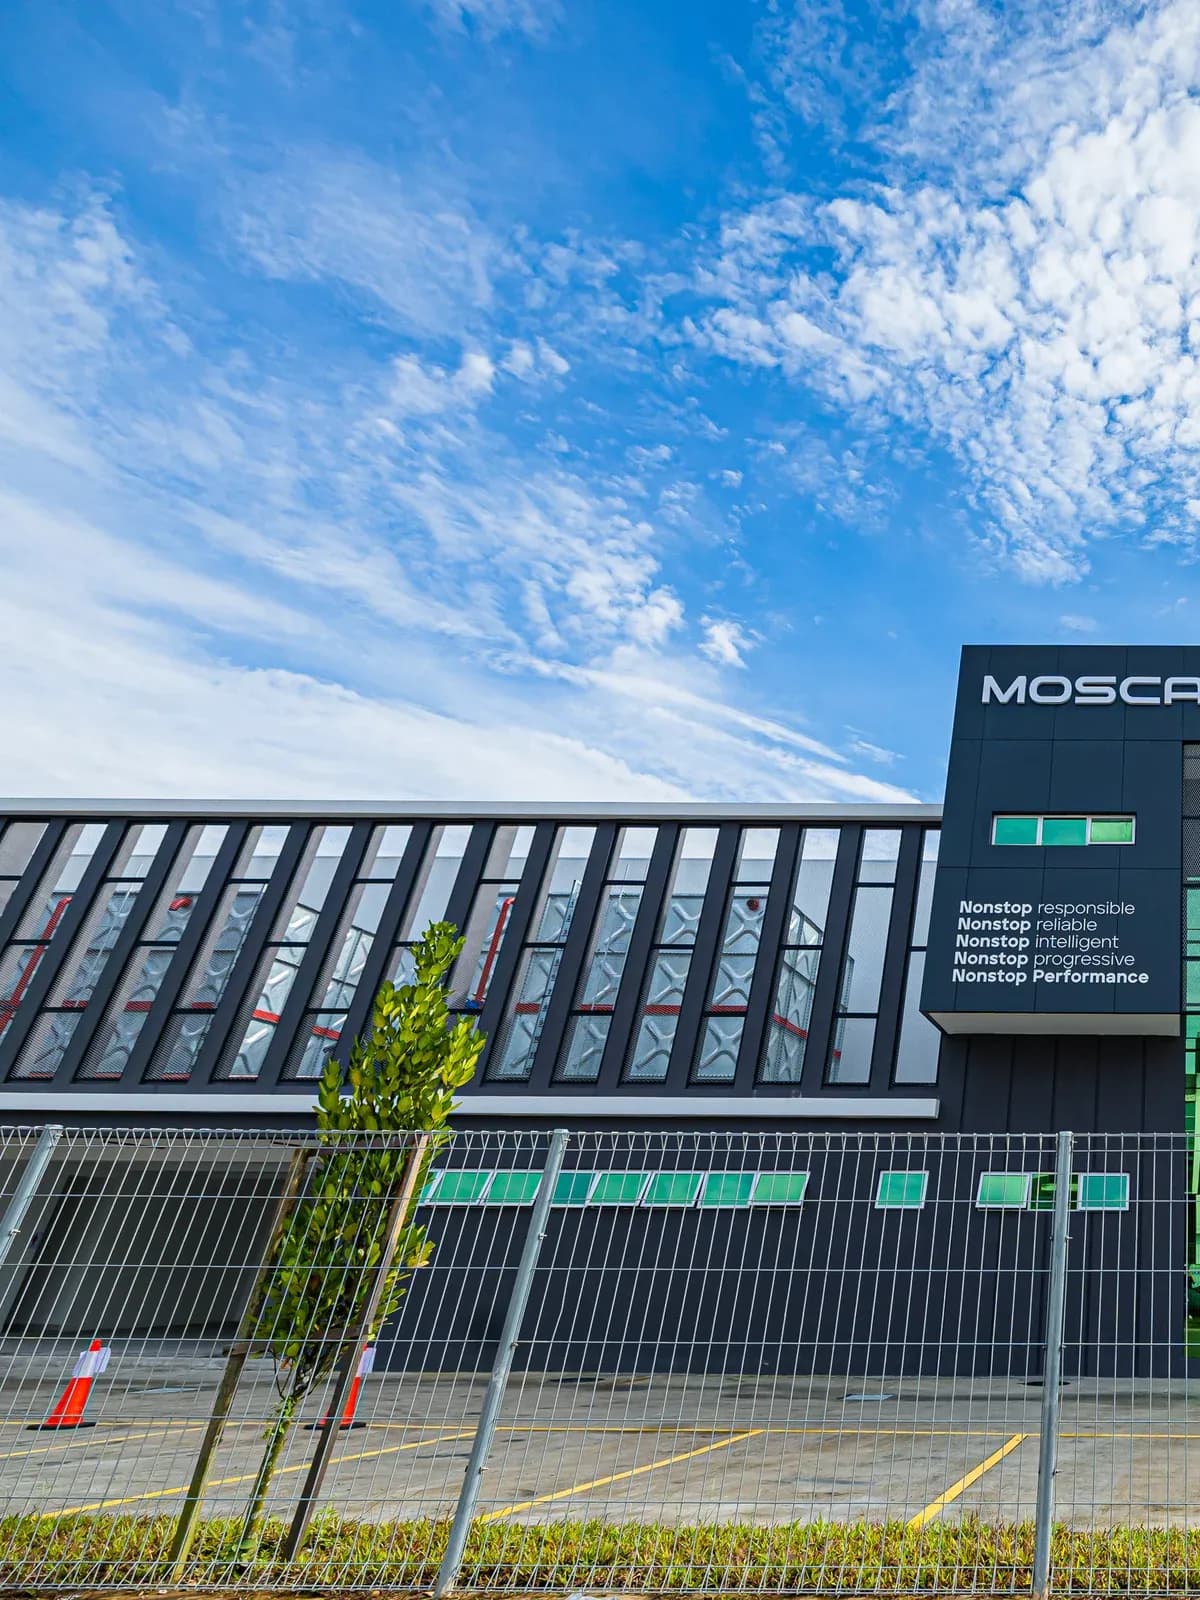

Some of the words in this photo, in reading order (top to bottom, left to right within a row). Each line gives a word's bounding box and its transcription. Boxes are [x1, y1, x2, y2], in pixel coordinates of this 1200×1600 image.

[959, 900, 1032, 917] Nonstop
[1038, 901, 1135, 917] responsible
[957, 917, 1031, 934] Nonstop
[1036, 918, 1097, 931] reliable
[956, 934, 1030, 951] Nonstop
[1035, 934, 1119, 952] intelligent
[954, 951, 1028, 968] Nonstop
[1033, 952, 1135, 969] progressive
[952, 968, 1027, 986] Nonstop
[1032, 969, 1149, 983] Performance
